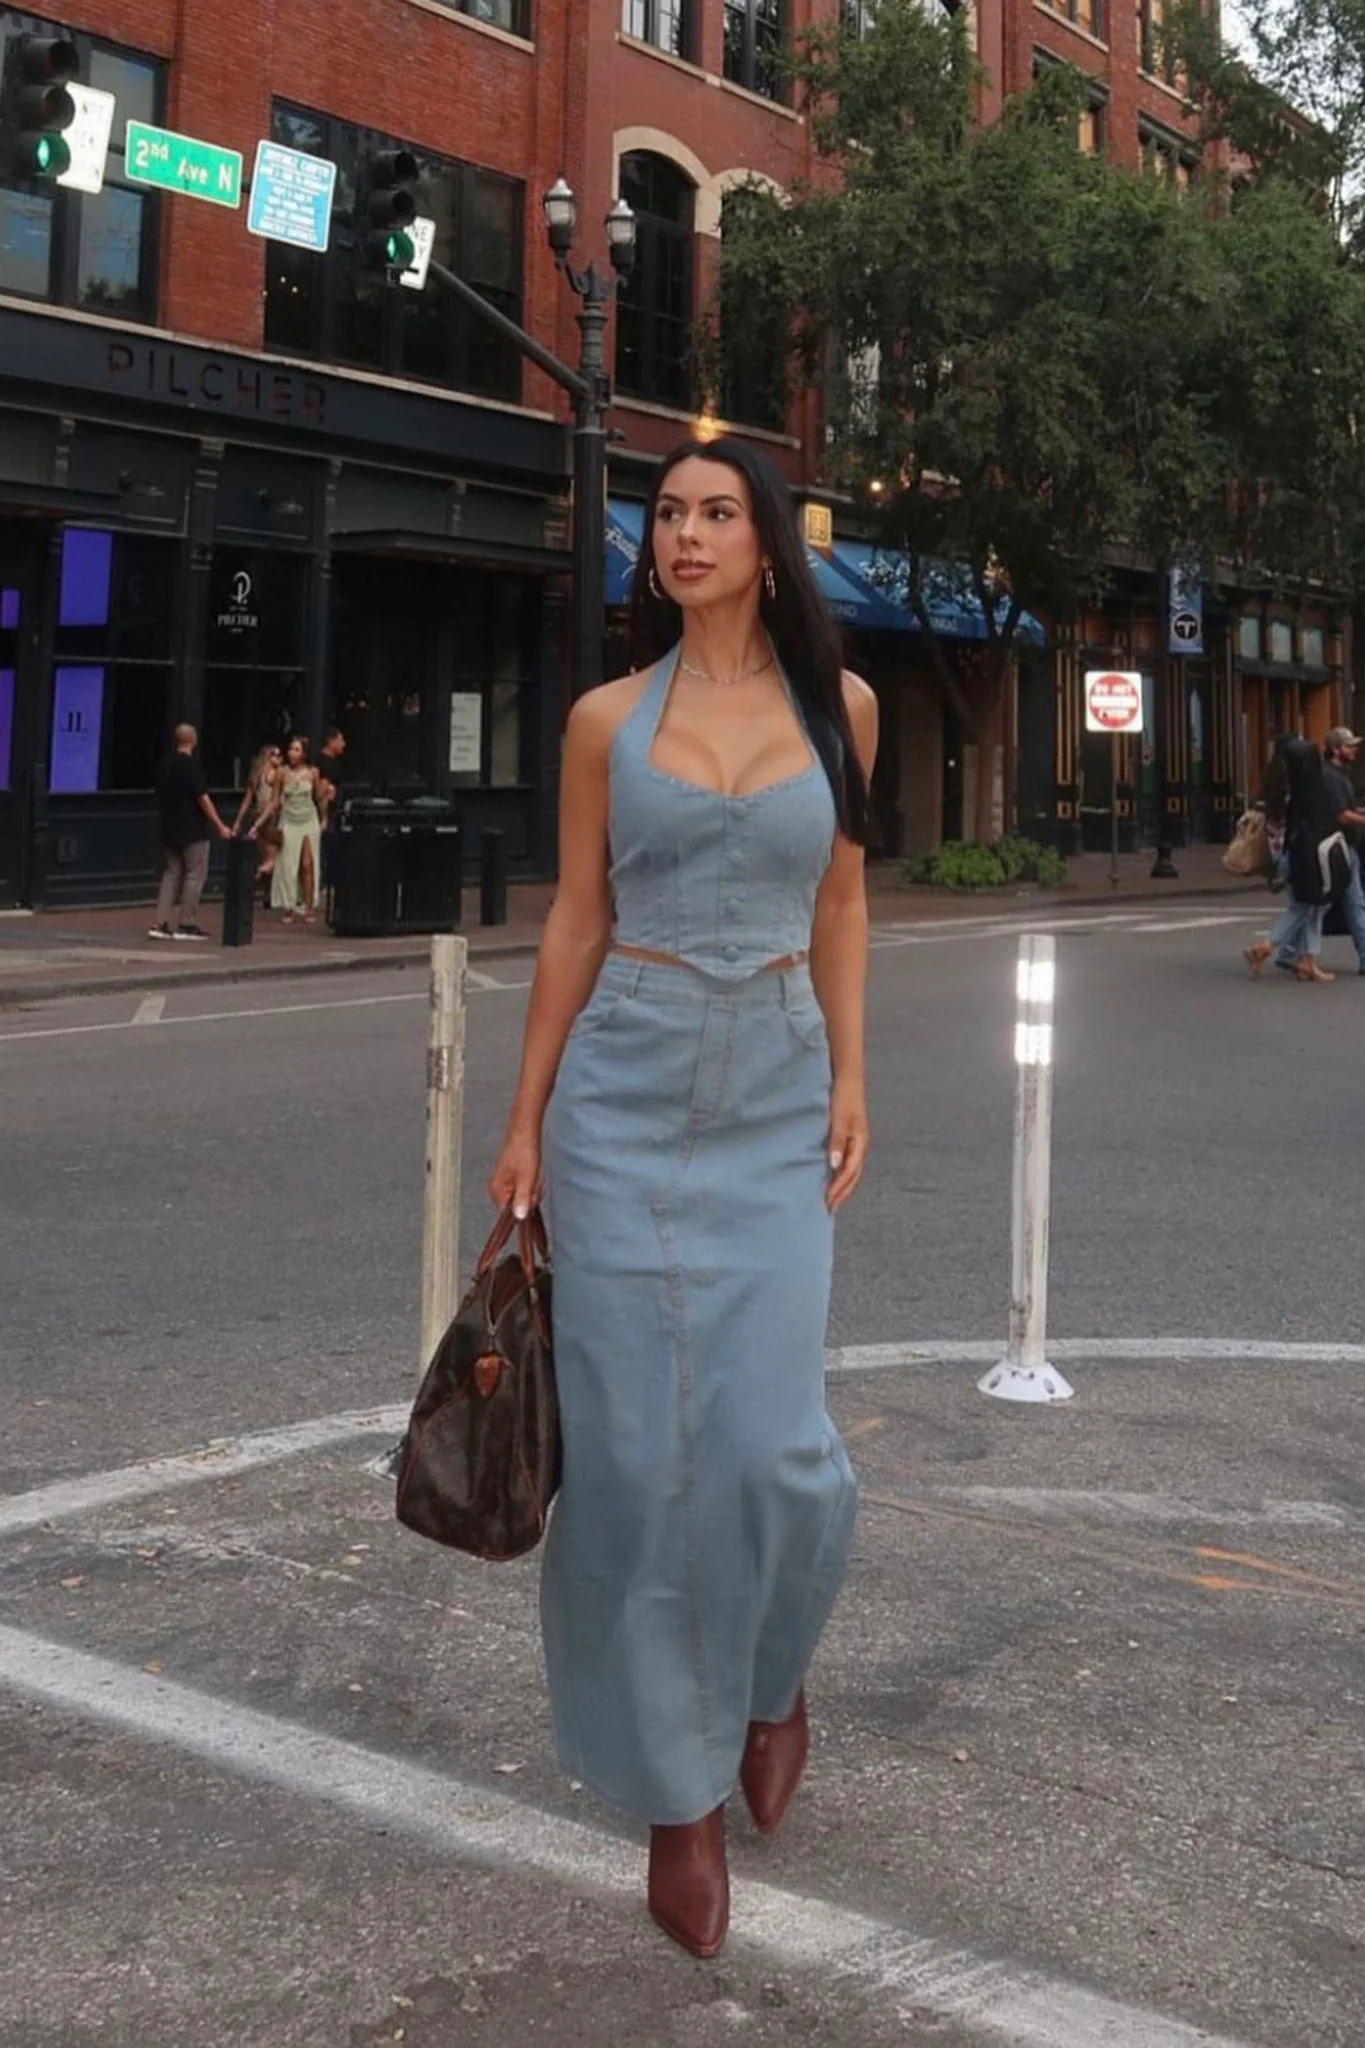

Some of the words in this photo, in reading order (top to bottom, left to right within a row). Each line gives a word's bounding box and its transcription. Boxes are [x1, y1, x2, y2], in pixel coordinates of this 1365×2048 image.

[135, 139, 169, 168] 2nd
[177, 157, 208, 184] Ave
[218, 163, 233, 192] N
[107, 343, 328, 423] PILCHER
